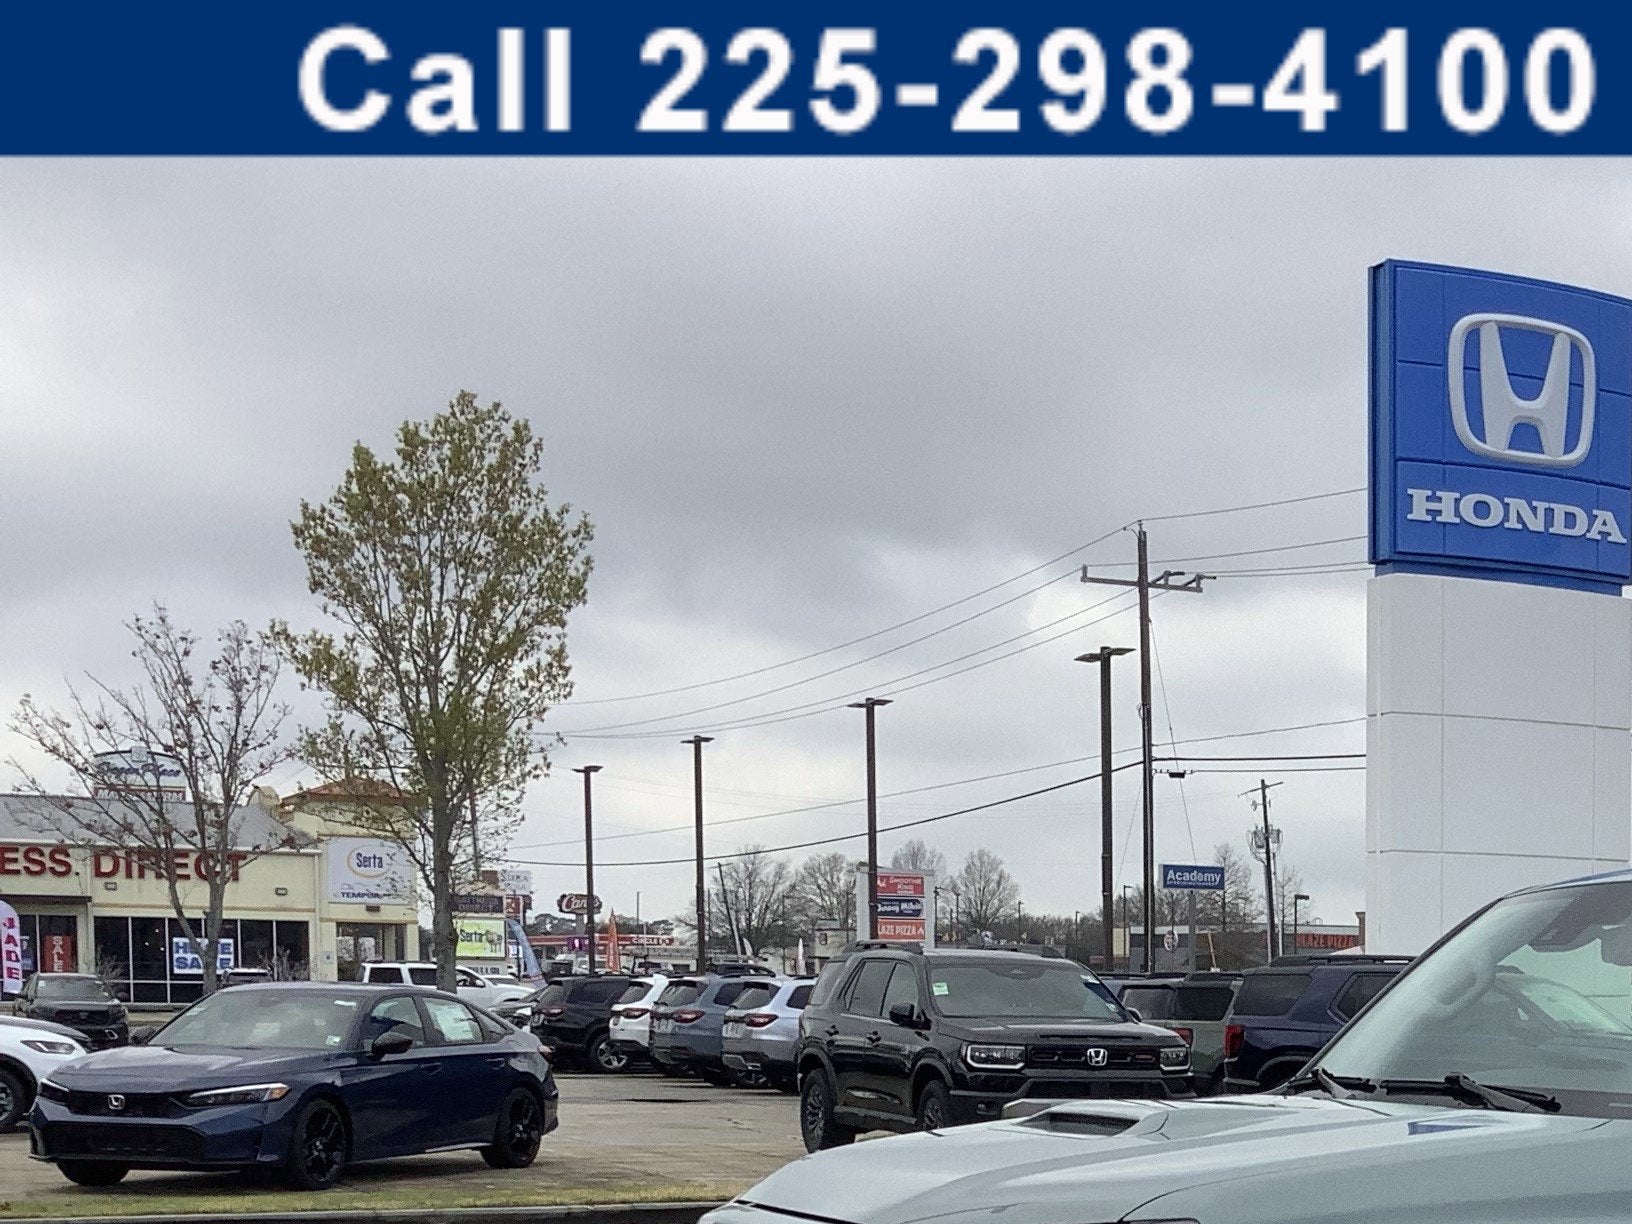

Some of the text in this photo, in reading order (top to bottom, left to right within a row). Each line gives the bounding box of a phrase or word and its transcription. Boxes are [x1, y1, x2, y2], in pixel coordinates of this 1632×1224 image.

[1406, 488, 1628, 545] HONDA
[356, 852, 383, 868] Serta
[1166, 869, 1221, 886] Academy
[877, 925, 895, 935] LAZE
[52, 936, 64, 973] SALE
[174, 941, 232, 955] HE
[175, 956, 231, 970] SAE
